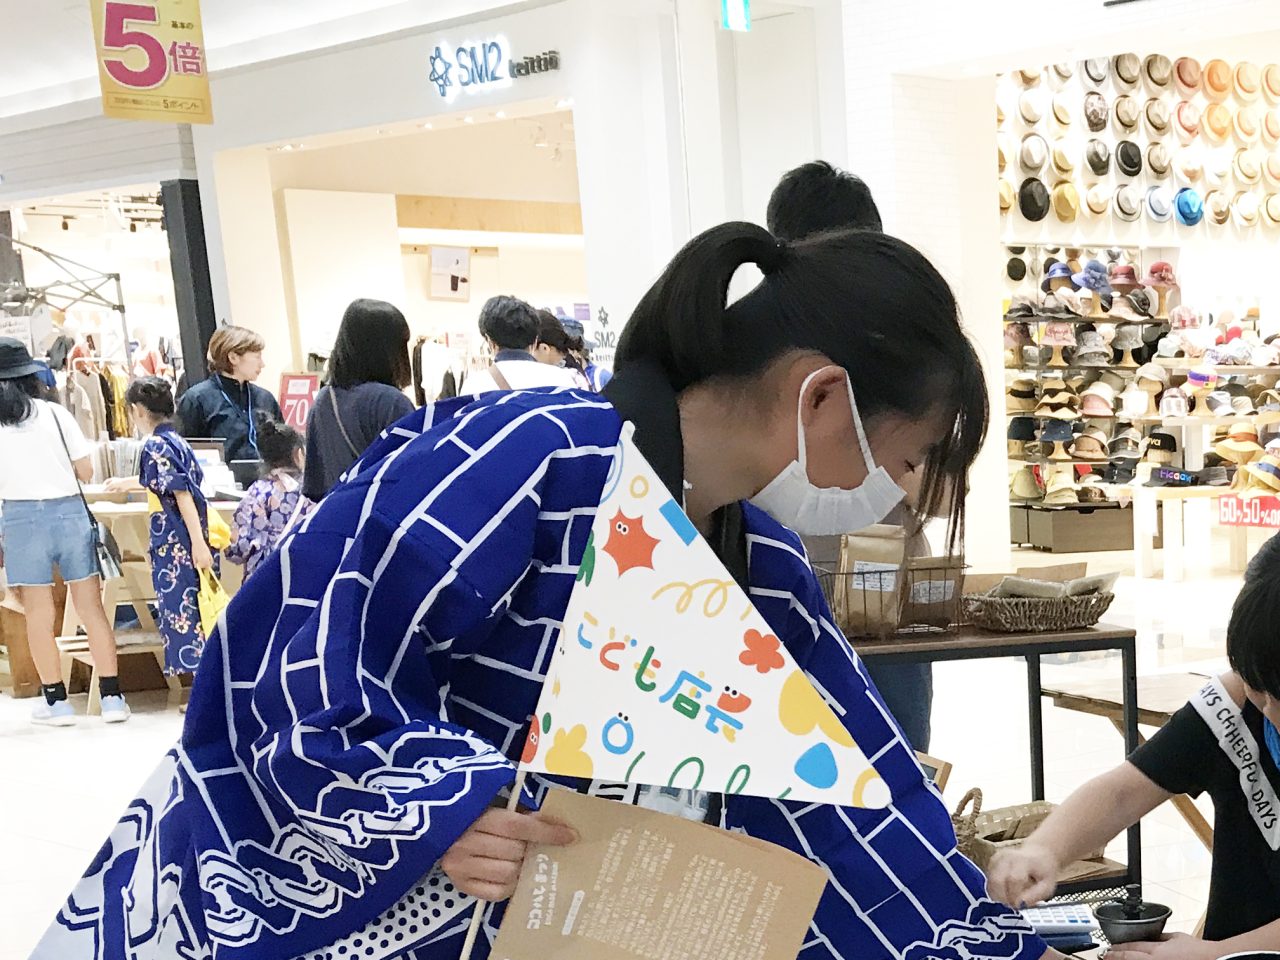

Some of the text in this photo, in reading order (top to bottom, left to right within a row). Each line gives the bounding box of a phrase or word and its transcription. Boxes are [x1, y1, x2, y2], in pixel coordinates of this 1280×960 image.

[456, 41, 503, 86] SM2
[594, 331, 616, 348] SM2
[578, 611, 752, 743] こども店長
[1252, 790, 1277, 830] DAYS
